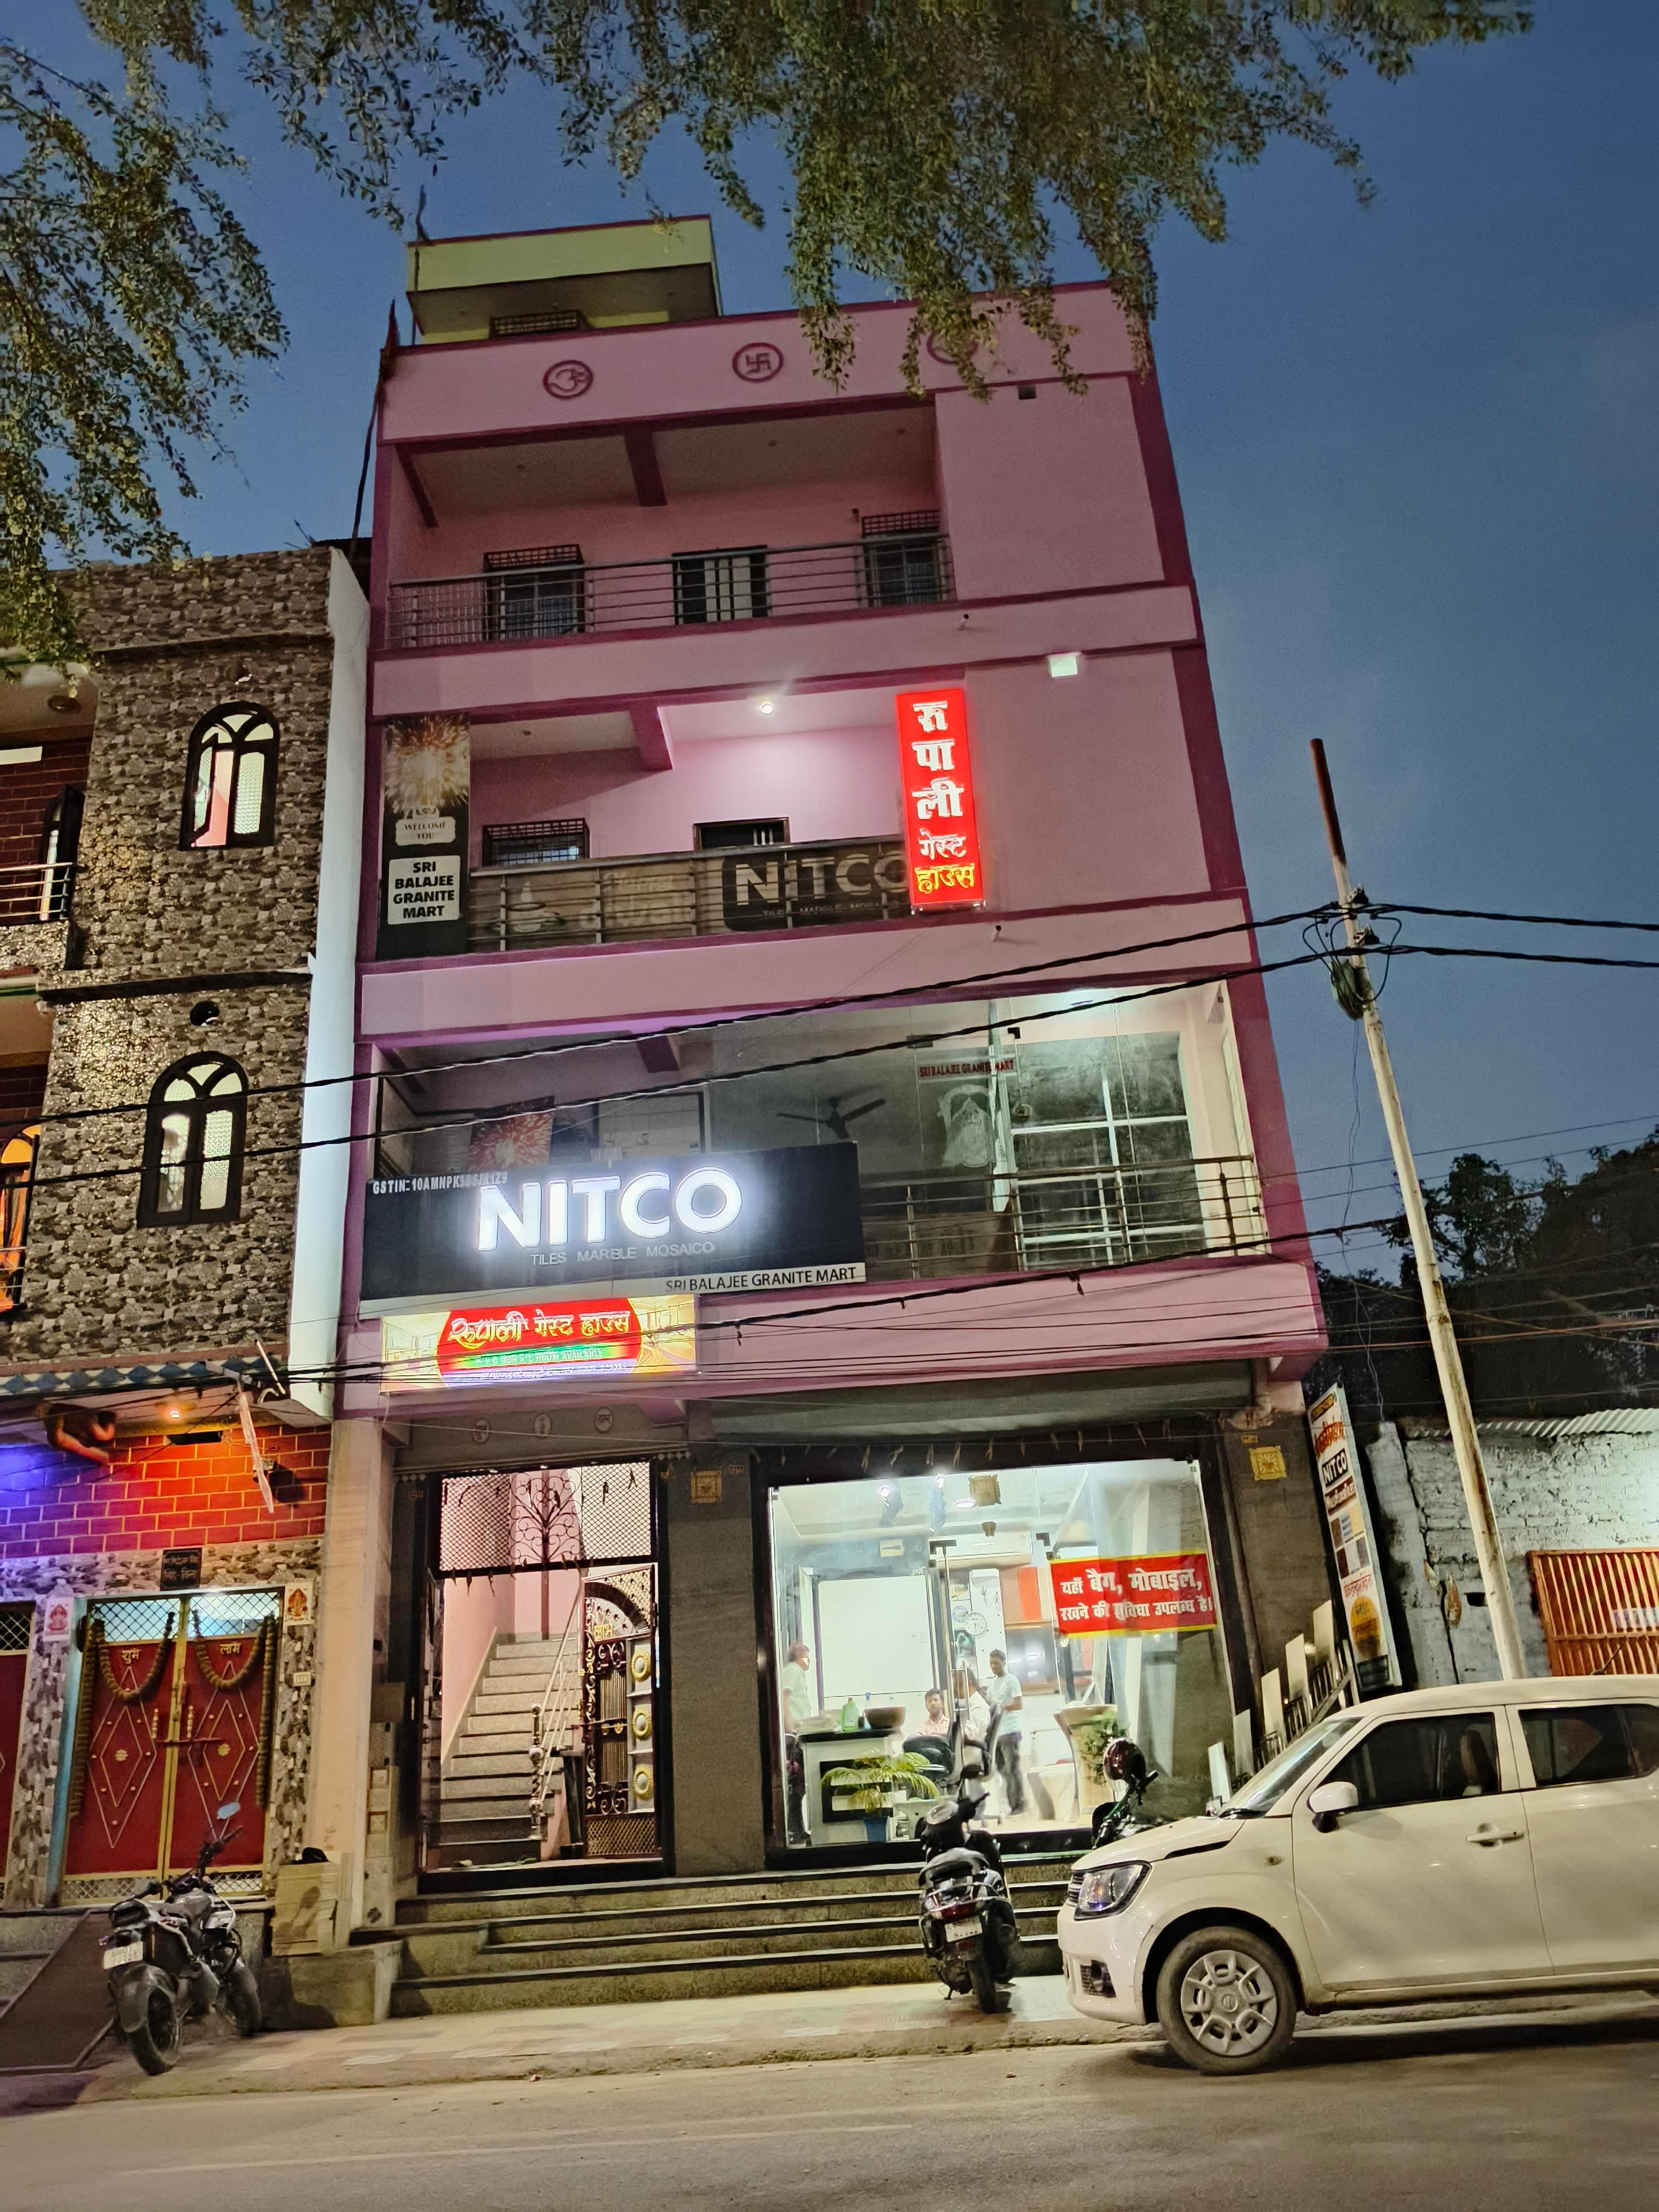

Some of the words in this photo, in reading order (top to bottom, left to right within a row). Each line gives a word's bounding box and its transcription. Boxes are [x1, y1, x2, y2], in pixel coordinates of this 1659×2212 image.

[405, 821, 446, 830] WELCOME
[919, 828, 966, 861] गेस्ट
[413, 861, 437, 873] SRI
[395, 875, 454, 890] BALAJEE
[736, 849, 908, 906] NITCO
[914, 863, 975, 894] हाउस
[393, 890, 455, 904] GRANITE
[403, 905, 445, 919] MART
[763, 909, 789, 918] TILE
[919, 1066, 931, 1077] SRI
[478, 1166, 743, 1251] NITCO
[530, 1252, 567, 1266] TILES
[577, 1247, 637, 1262] MARBLE
[646, 1242, 715, 1257] MOSAICO
[666, 1280, 686, 1292] SRI
[689, 1275, 748, 1291] BALAJEE
[752, 1270, 812, 1286] GRANITE
[816, 1267, 856, 1282] MART
[534, 1308, 574, 1338] गेस्ट
[580, 1311, 631, 1337] हाउस
[562, 1348, 605, 1360] AVAILABLE
[1322, 1452, 1347, 1484] NITCO
[1060, 1603, 1089, 1621] रखने
[1092, 1601, 1110, 1618] की
